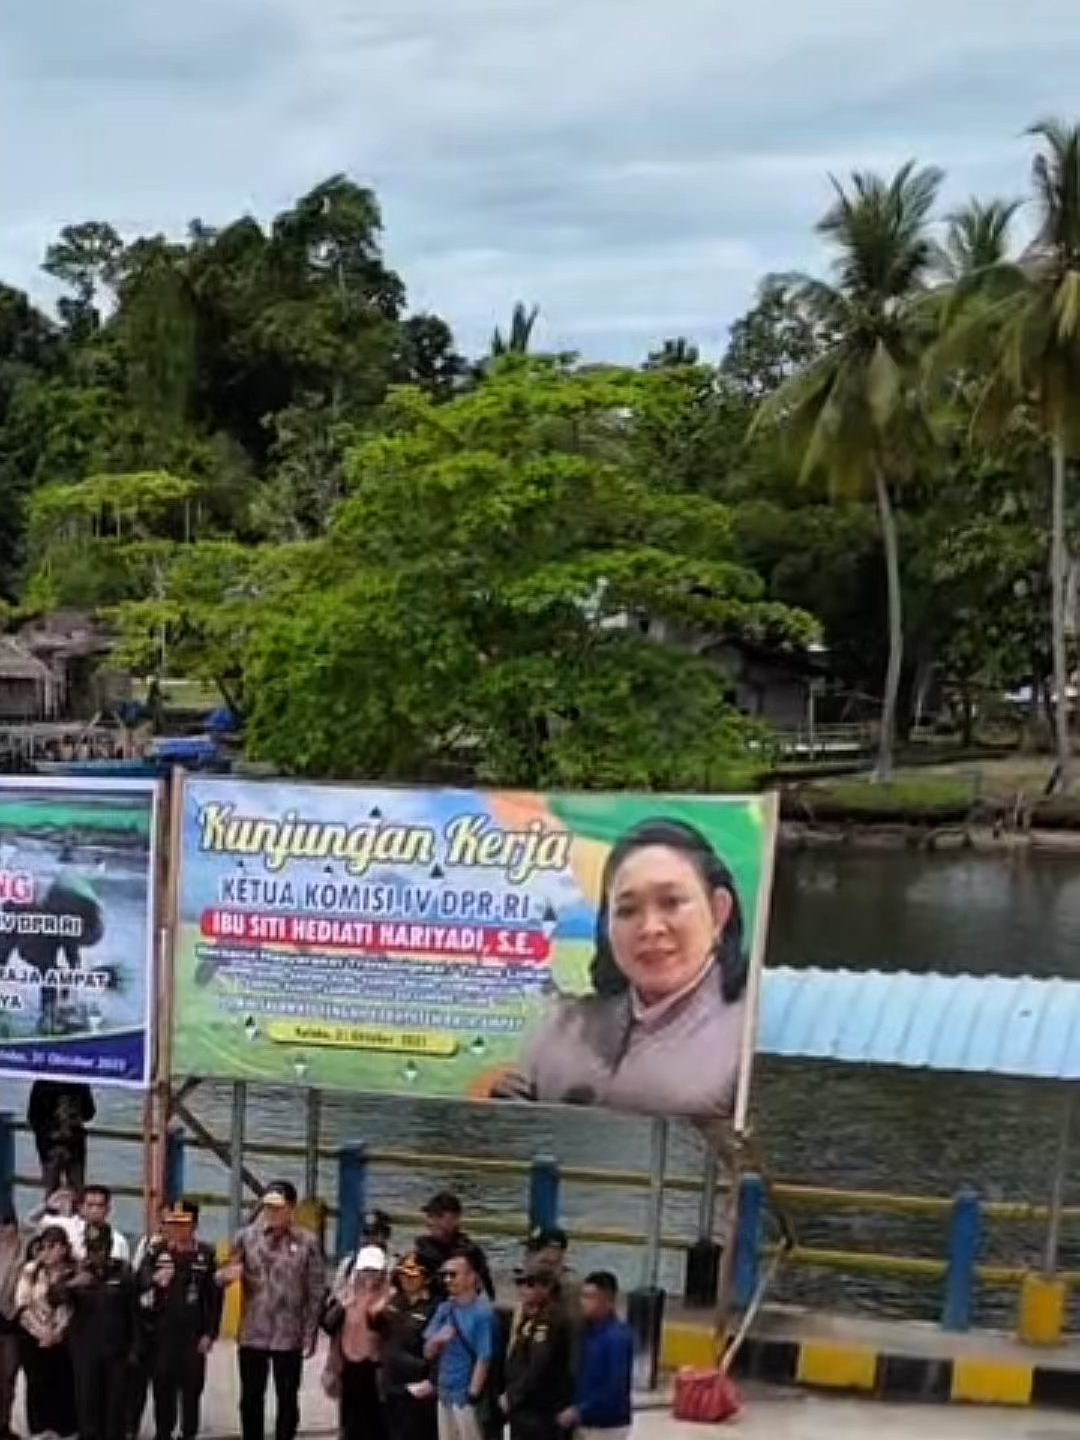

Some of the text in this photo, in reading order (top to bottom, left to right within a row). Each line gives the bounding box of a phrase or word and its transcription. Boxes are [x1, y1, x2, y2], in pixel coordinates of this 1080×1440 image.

[199, 801, 570, 882] Kunjungan Kerja
[222, 877, 294, 904] KETUA
[306, 882, 394, 913] KOMISI
[404, 887, 431, 913] IV
[19, 917, 56, 932] DPR
[61, 919, 80, 935] RI
[211, 910, 535, 955] IBU SITI HEDIATI HARIYADI, S.E.
[45, 972, 108, 989] AMPAT
